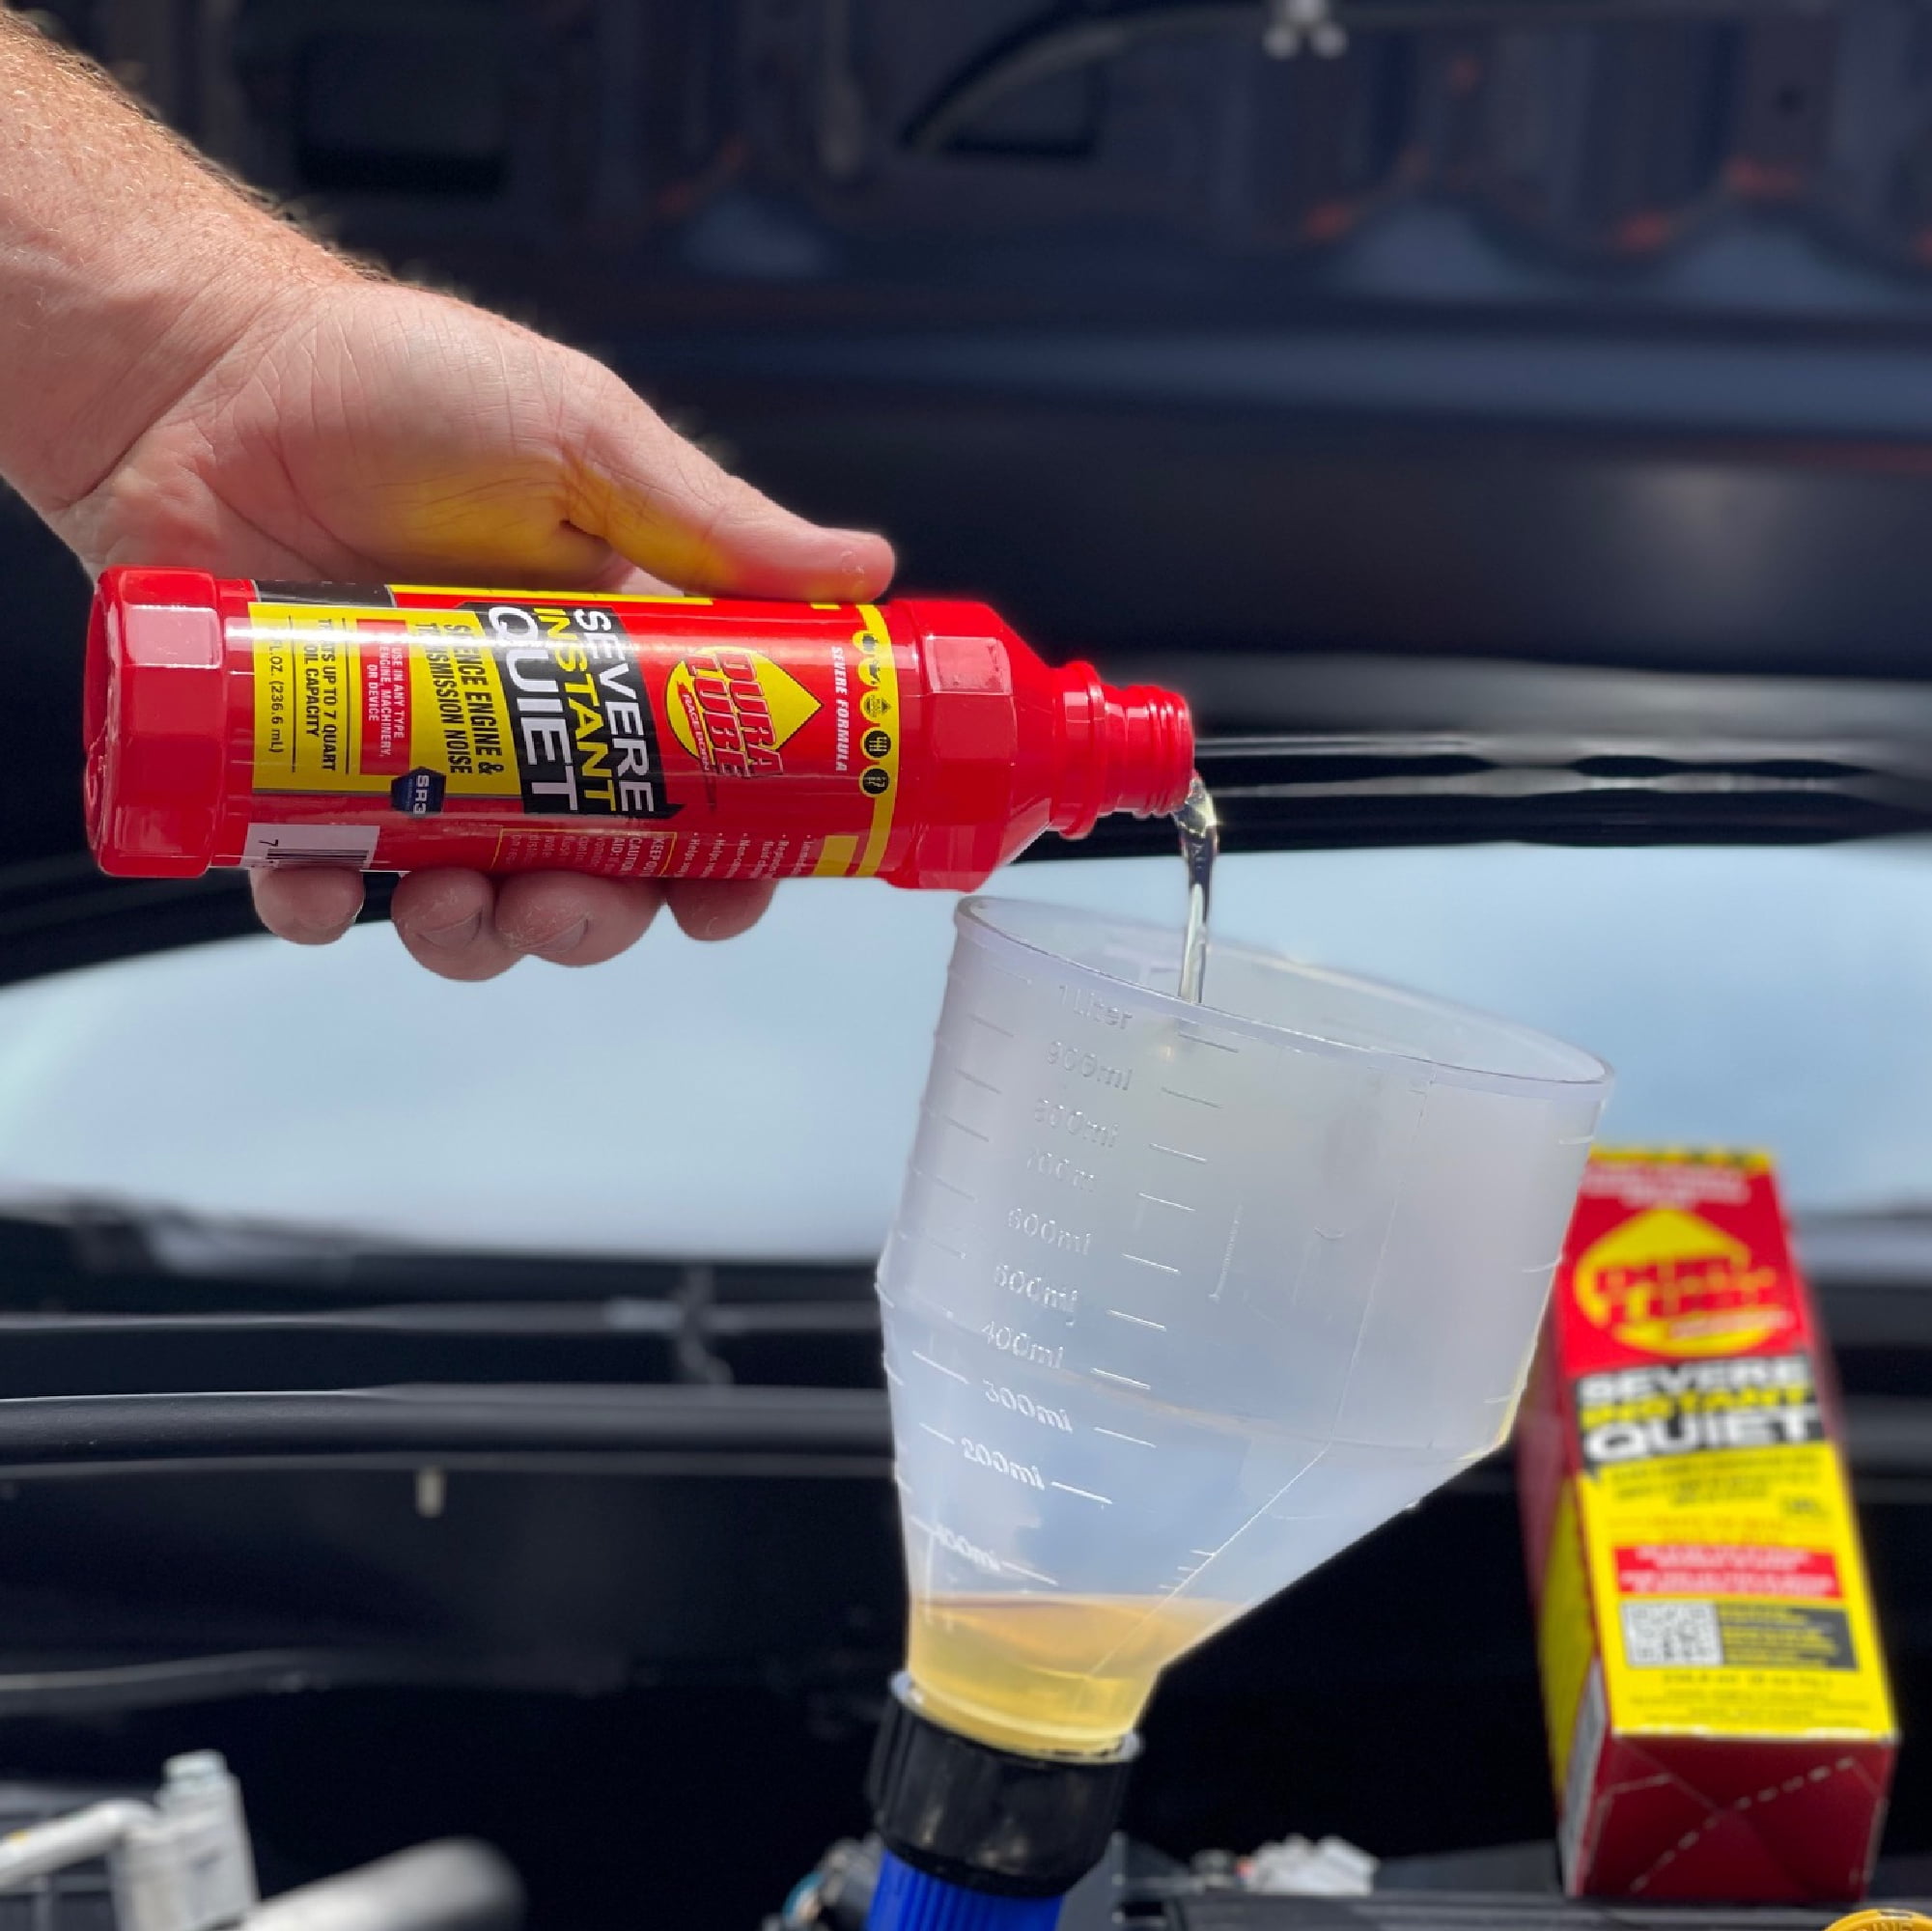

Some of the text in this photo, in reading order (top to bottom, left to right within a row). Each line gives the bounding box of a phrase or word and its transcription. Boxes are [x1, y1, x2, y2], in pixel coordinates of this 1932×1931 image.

[303, 644, 320, 738] OIL CAPACITY
[322, 667, 337, 686] UP
[323, 687, 337, 707] TO
[366, 663, 379, 721] OR DEVICE
[393, 669, 404, 682] IN
[393, 684, 405, 707] ANY
[323, 710, 337, 720] 7
[394, 710, 406, 739] TYPE
[464, 691, 503, 757] ENGINE
[488, 606, 578, 811] QUIET
[533, 607, 617, 812] INSTANT
[573, 608, 655, 813] SEVERE
[685, 653, 751, 778] LUBE
[715, 651, 784, 776] DURA
[831, 646, 850, 771] SEVERE FORMULA
[268, 728, 284, 753] mL)
[322, 724, 337, 771] QUART
[443, 729, 473, 774] NOISE
[477, 761, 504, 775] &
[412, 774, 430, 815] SR3
[981, 1320, 1064, 1369] 400ml
[983, 1379, 1074, 1435] 300ml
[1583, 1404, 1817, 1464] QUIET
[961, 1437, 1046, 1490] 200ml
